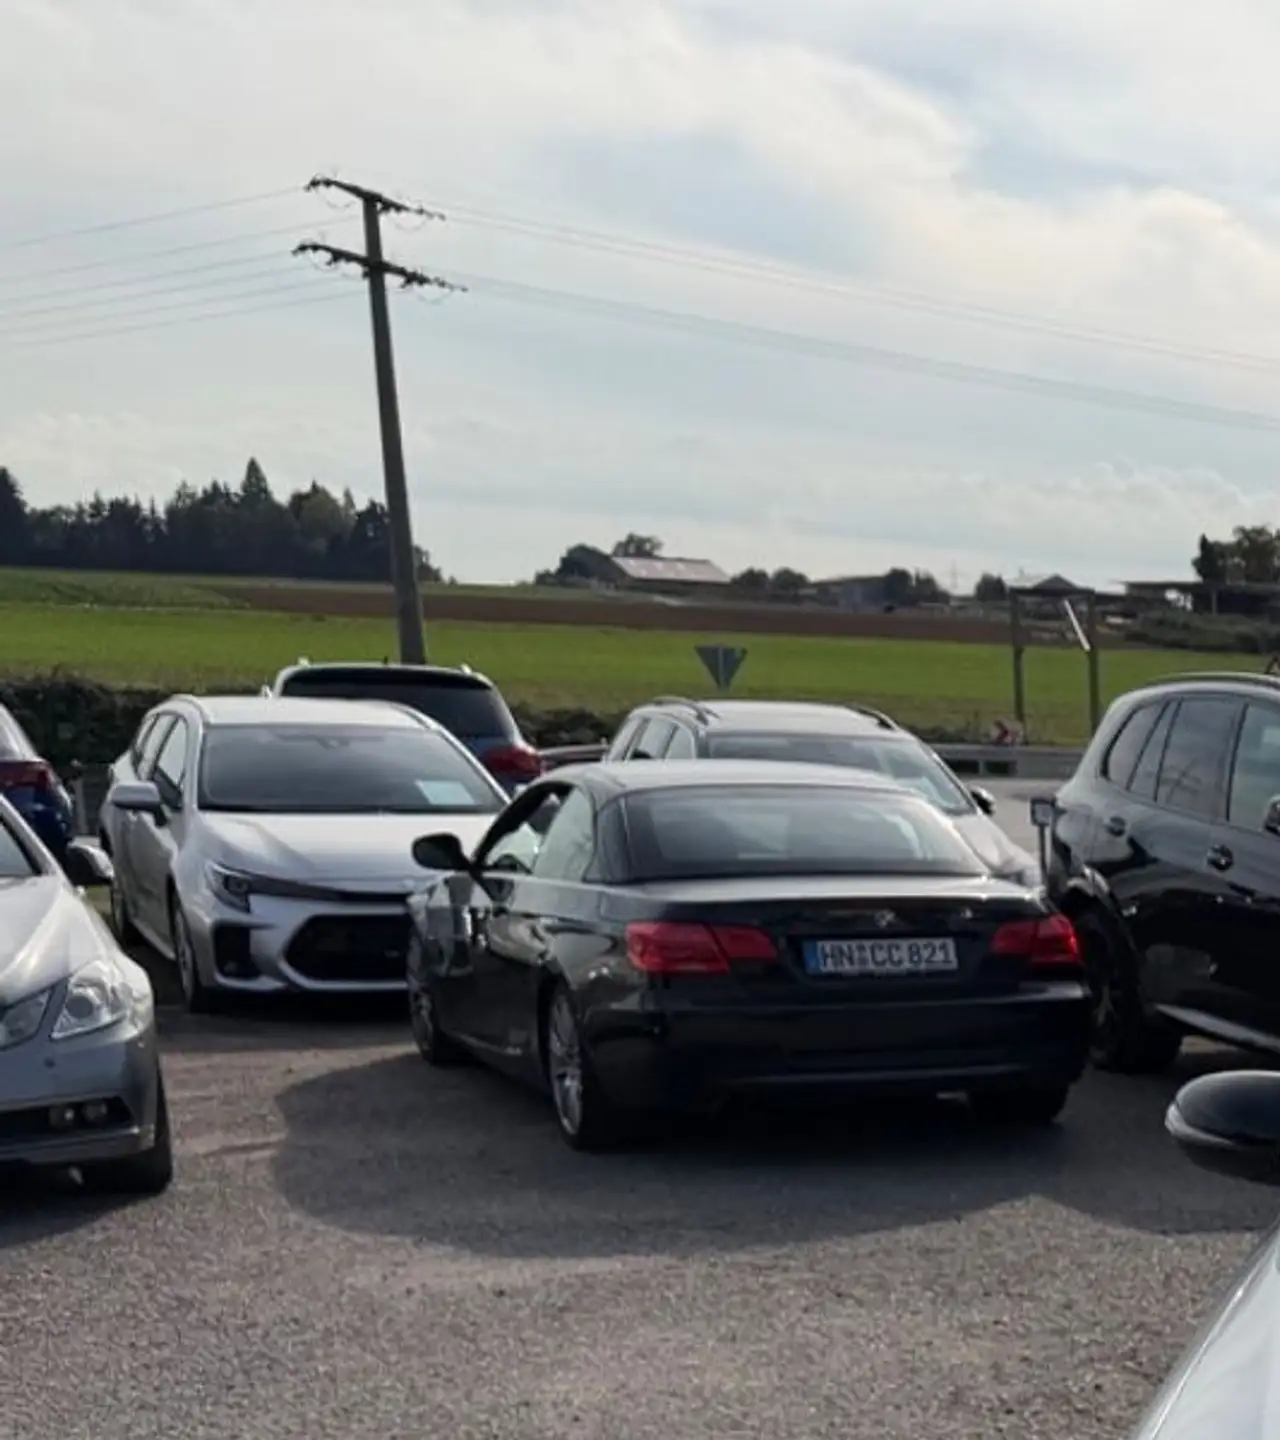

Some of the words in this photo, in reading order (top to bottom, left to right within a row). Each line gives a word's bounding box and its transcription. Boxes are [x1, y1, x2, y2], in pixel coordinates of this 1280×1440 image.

[822, 942, 855, 967] HN
[870, 941, 903, 966] CC
[908, 939, 953, 965] 821
